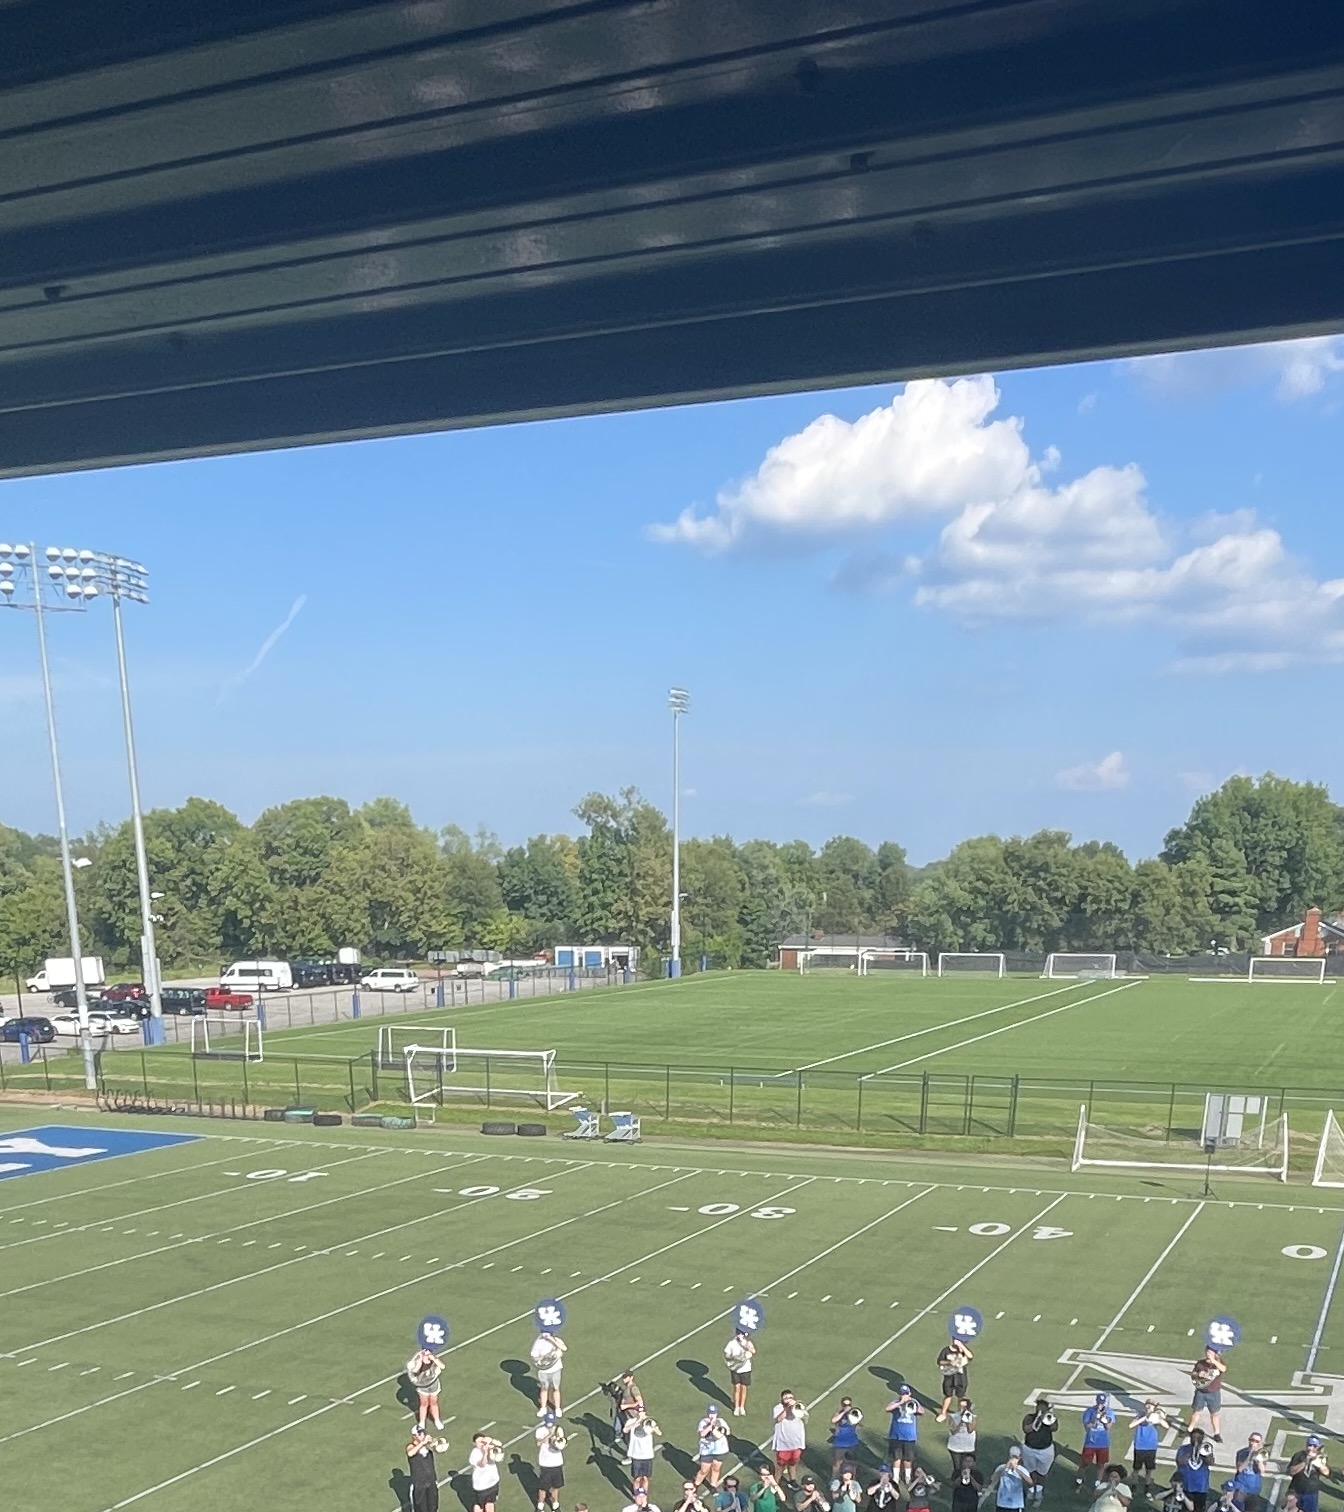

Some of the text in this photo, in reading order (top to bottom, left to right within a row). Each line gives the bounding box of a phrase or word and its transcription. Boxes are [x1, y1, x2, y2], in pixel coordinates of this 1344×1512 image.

[538, 1306, 561, 1326] UK
[740, 1305, 759, 1329] UK
[954, 1314, 976, 1336] UK
[424, 1323, 444, 1344] UK
[1209, 1322, 1234, 1346] UK
